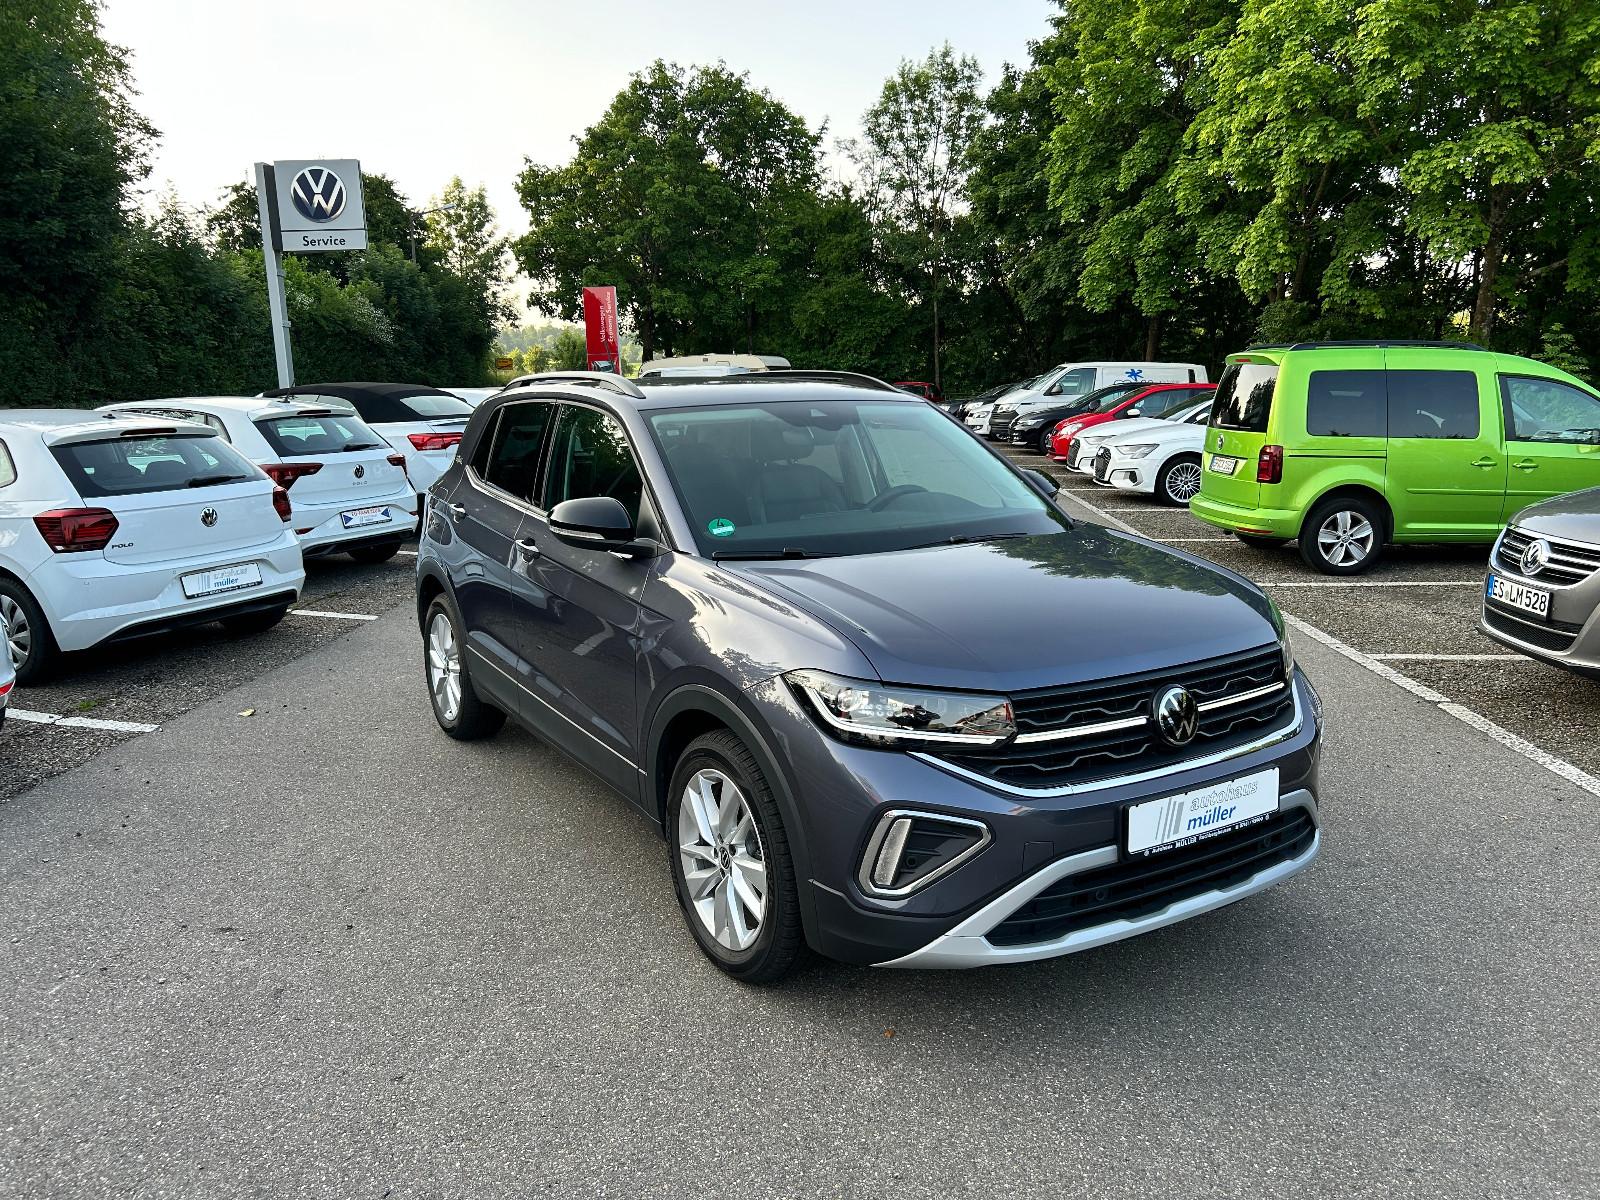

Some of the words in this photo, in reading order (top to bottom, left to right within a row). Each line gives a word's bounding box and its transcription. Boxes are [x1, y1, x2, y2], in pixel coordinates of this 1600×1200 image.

[302, 235, 346, 247] Service
[716, 519, 725, 527] 4
[213, 576, 239, 588] müller
[1492, 579, 1505, 599] ES
[1190, 781, 1258, 811] autohaus
[1186, 804, 1237, 831] müller
